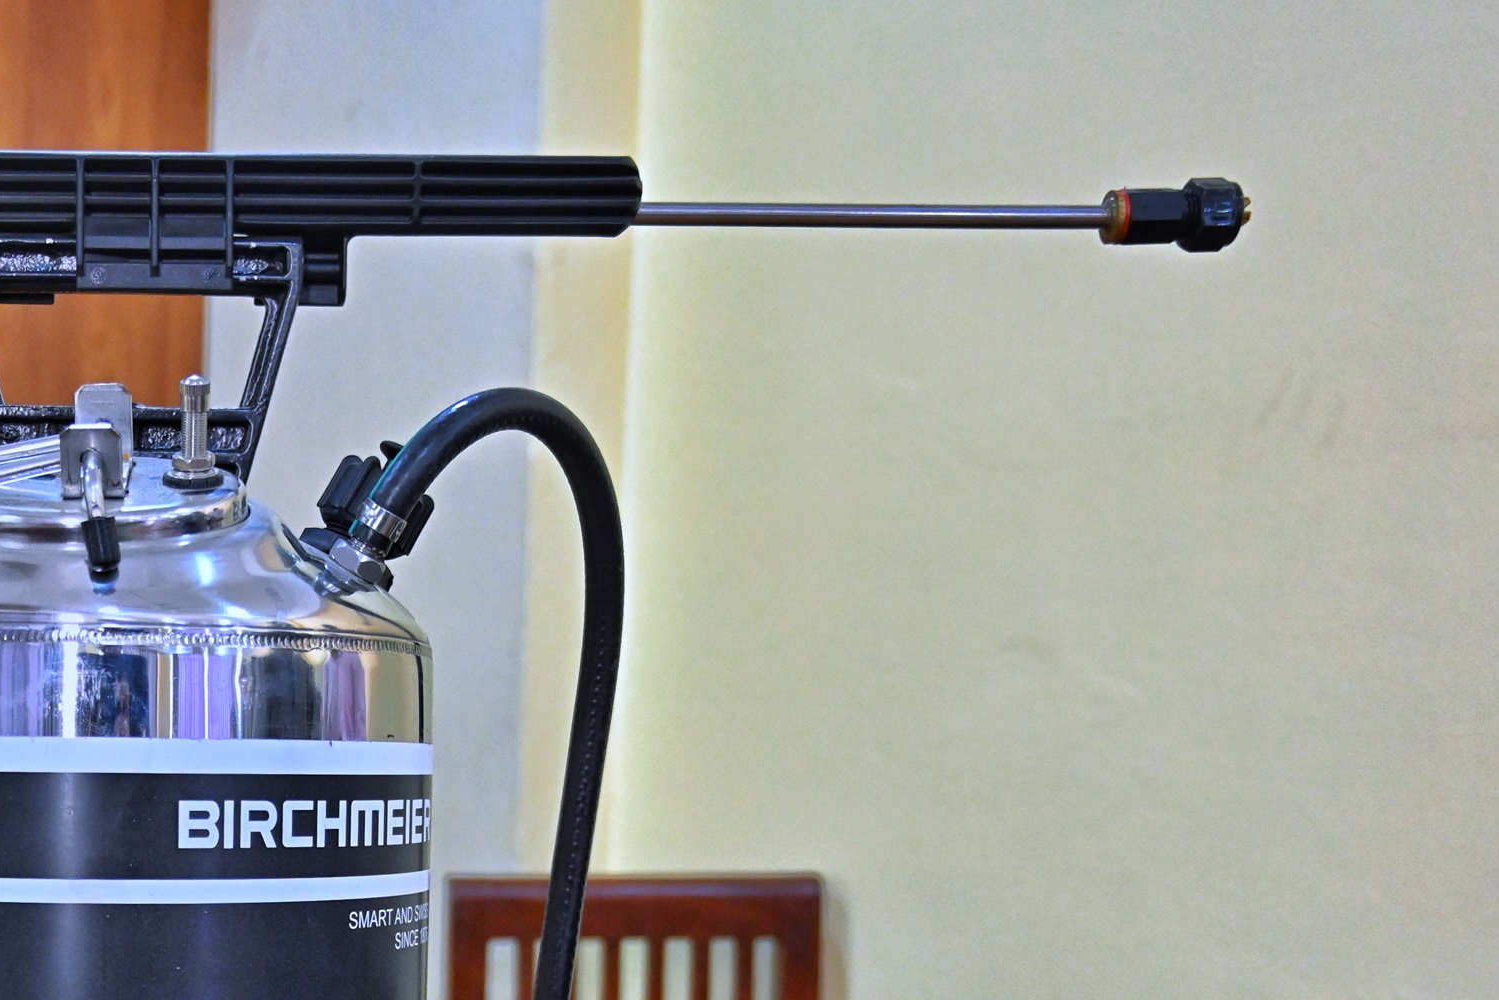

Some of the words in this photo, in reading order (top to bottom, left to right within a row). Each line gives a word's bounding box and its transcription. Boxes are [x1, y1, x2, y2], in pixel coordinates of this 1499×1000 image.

[178, 799, 430, 849] BIRCHMEIER
[349, 909, 393, 930] SMART
[395, 906, 413, 926] AND
[395, 928, 419, 949] SINCE
